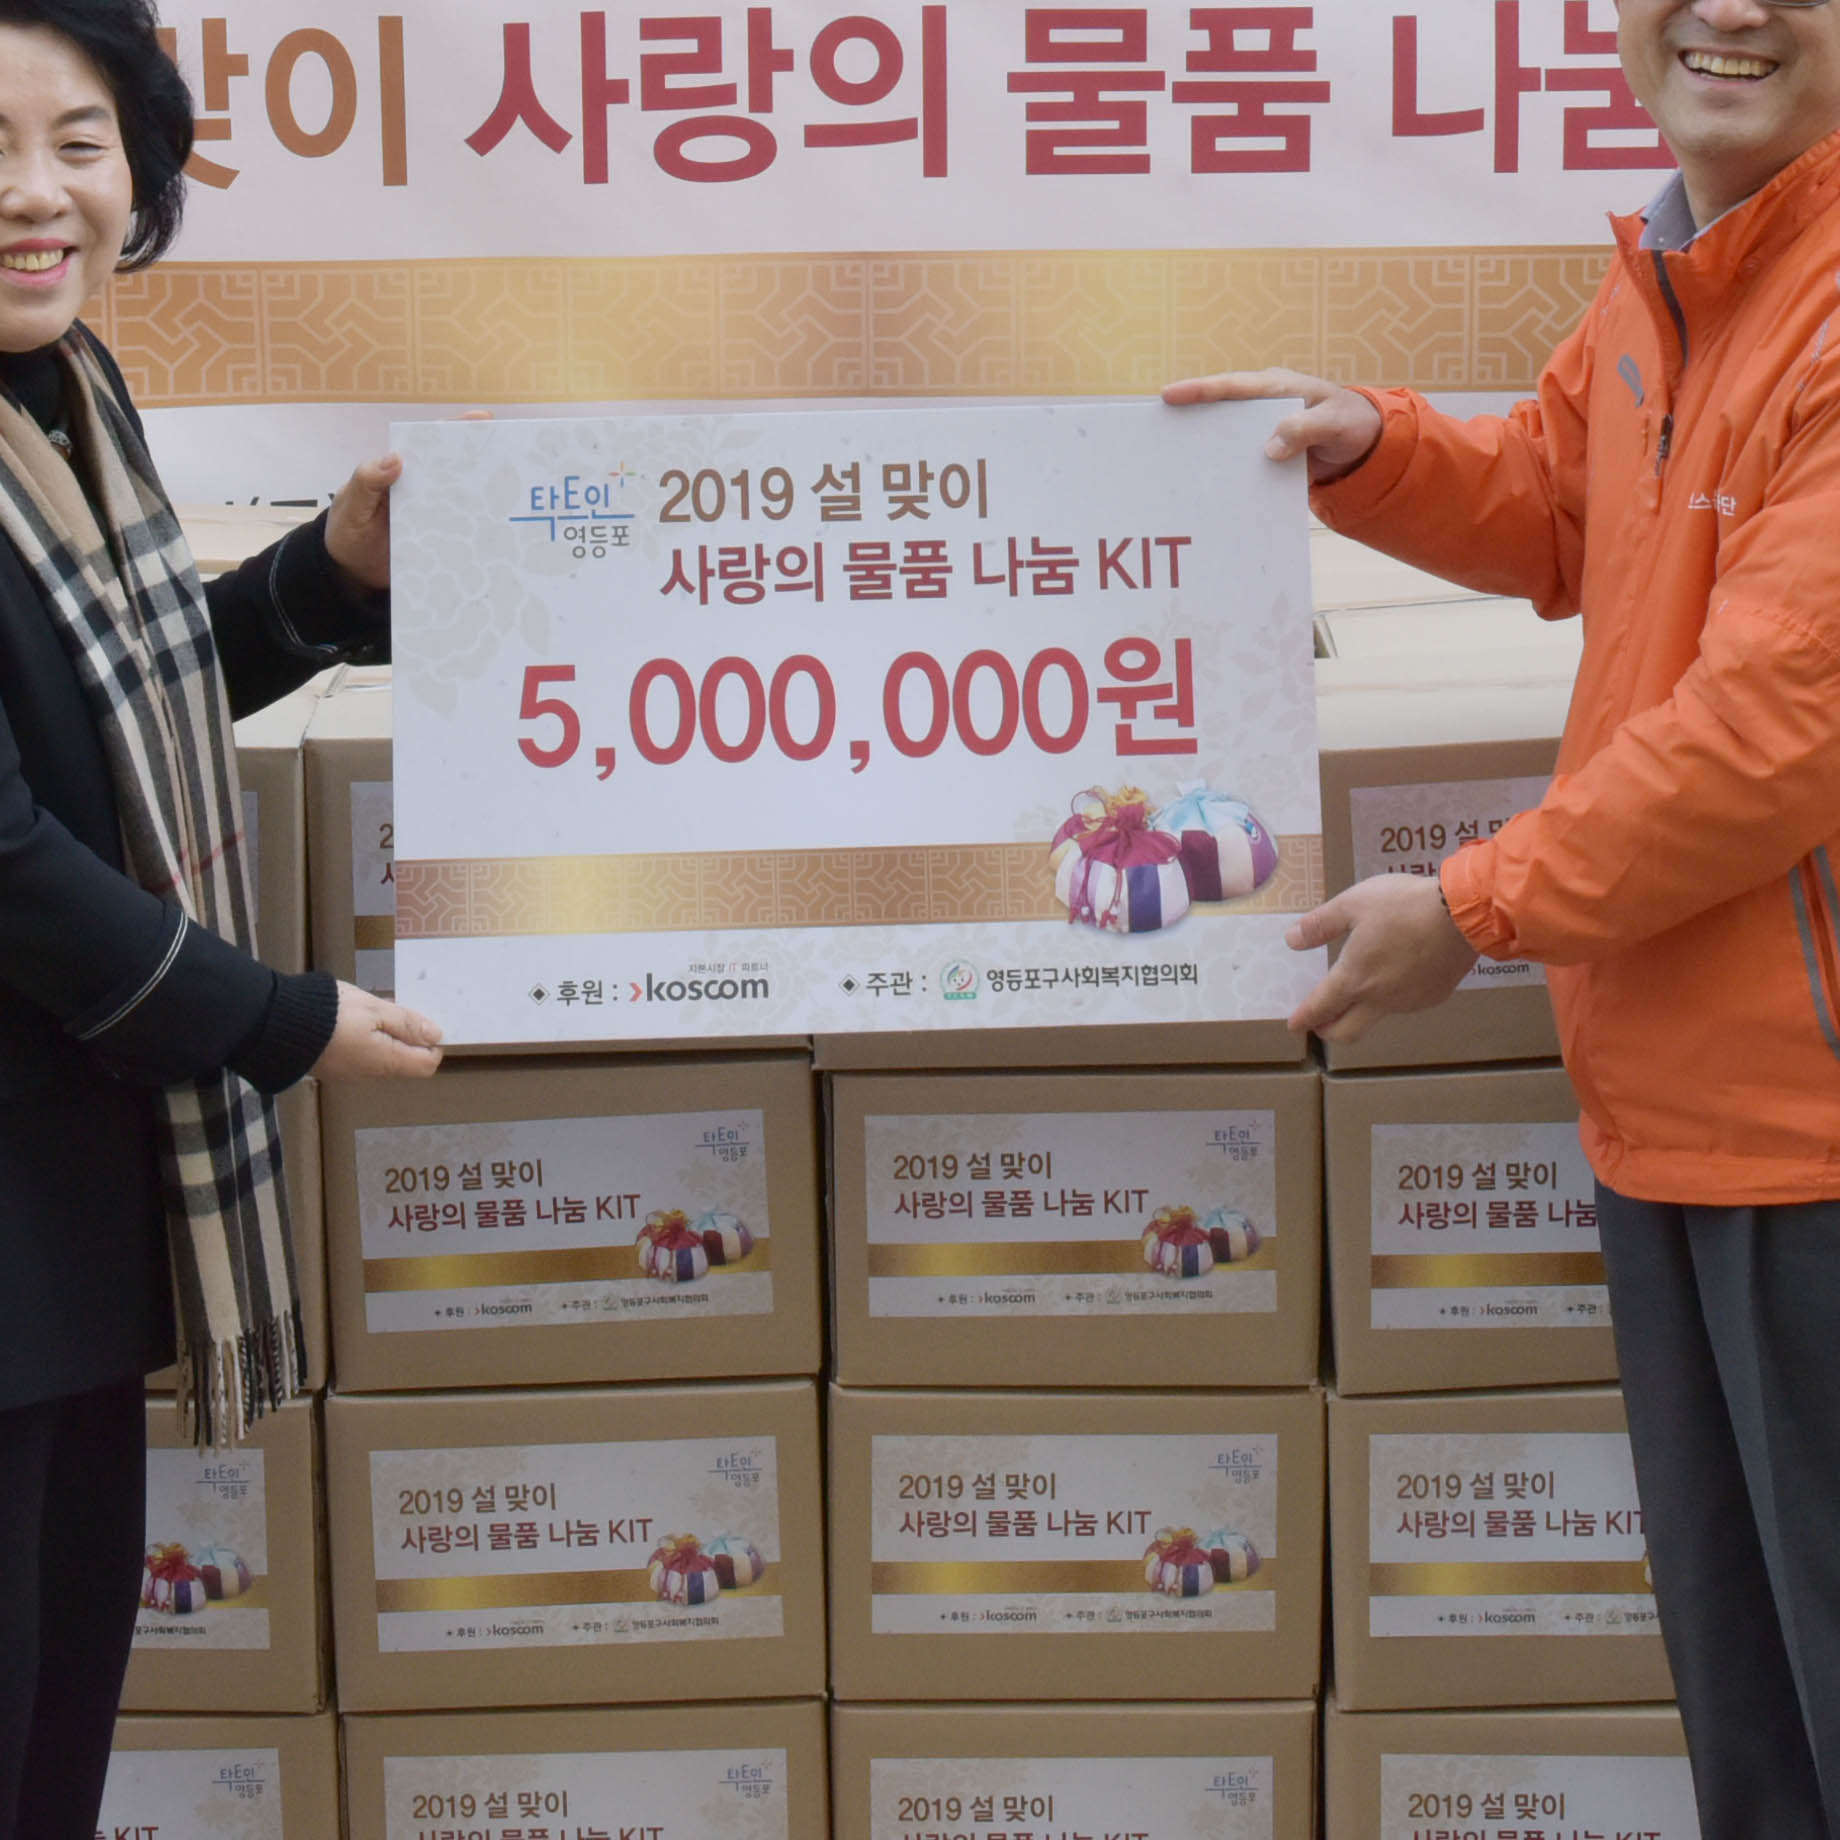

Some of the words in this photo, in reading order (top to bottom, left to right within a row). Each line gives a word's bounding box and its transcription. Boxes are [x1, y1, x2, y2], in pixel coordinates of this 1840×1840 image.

[464, 4, 948, 185] 사랑의
[1007, 6, 1330, 175] 물품
[659, 467, 794, 525] 2019
[810, 463, 862, 522] 설
[881, 458, 989, 522] 맞이
[563, 525, 631, 559] 영등포
[660, 542, 825, 607] 사랑의
[842, 539, 952, 601] 물품
[972, 535, 1079, 600] 나눔
[1098, 536, 1192, 590] KIT
[517, 637, 1199, 779] 5,000,000원
[1379, 824, 1447, 854] 2019
[865, 972, 913, 998] 주관
[986, 963, 1198, 993] 영등포구사회복지협의회
[1477, 962, 1530, 977] koscom
[556, 979, 604, 1007] 후원
[645, 972, 769, 1002] koscom
[384, 1165, 450, 1194] 2019
[457, 1162, 483, 1191] 설
[490, 1159, 543, 1190] 맞이
[893, 1154, 959, 1180] 2019
[966, 1152, 991, 1180] 설
[1000, 1151, 1051, 1180] 맞이
[387, 1201, 466, 1233] 사랑의
[474, 1199, 527, 1229] 물품
[535, 1196, 588, 1225] 나눔
[595, 1194, 641, 1220] KIT
[894, 1190, 973, 1220] 사랑의
[981, 1190, 1035, 1218] 물품
[1043, 1189, 1096, 1217] 나눔
[1103, 1189, 1150, 1214] KIT
[898, 1474, 964, 1500] 2019
[971, 1473, 996, 1500] 설
[1005, 1472, 1056, 1500] 맞이
[899, 1510, 977, 1539] 사랑의
[985, 1510, 1038, 1538] 물품
[1047, 1509, 1099, 1537] 나눔
[1106, 1510, 1152, 1534] KIT
